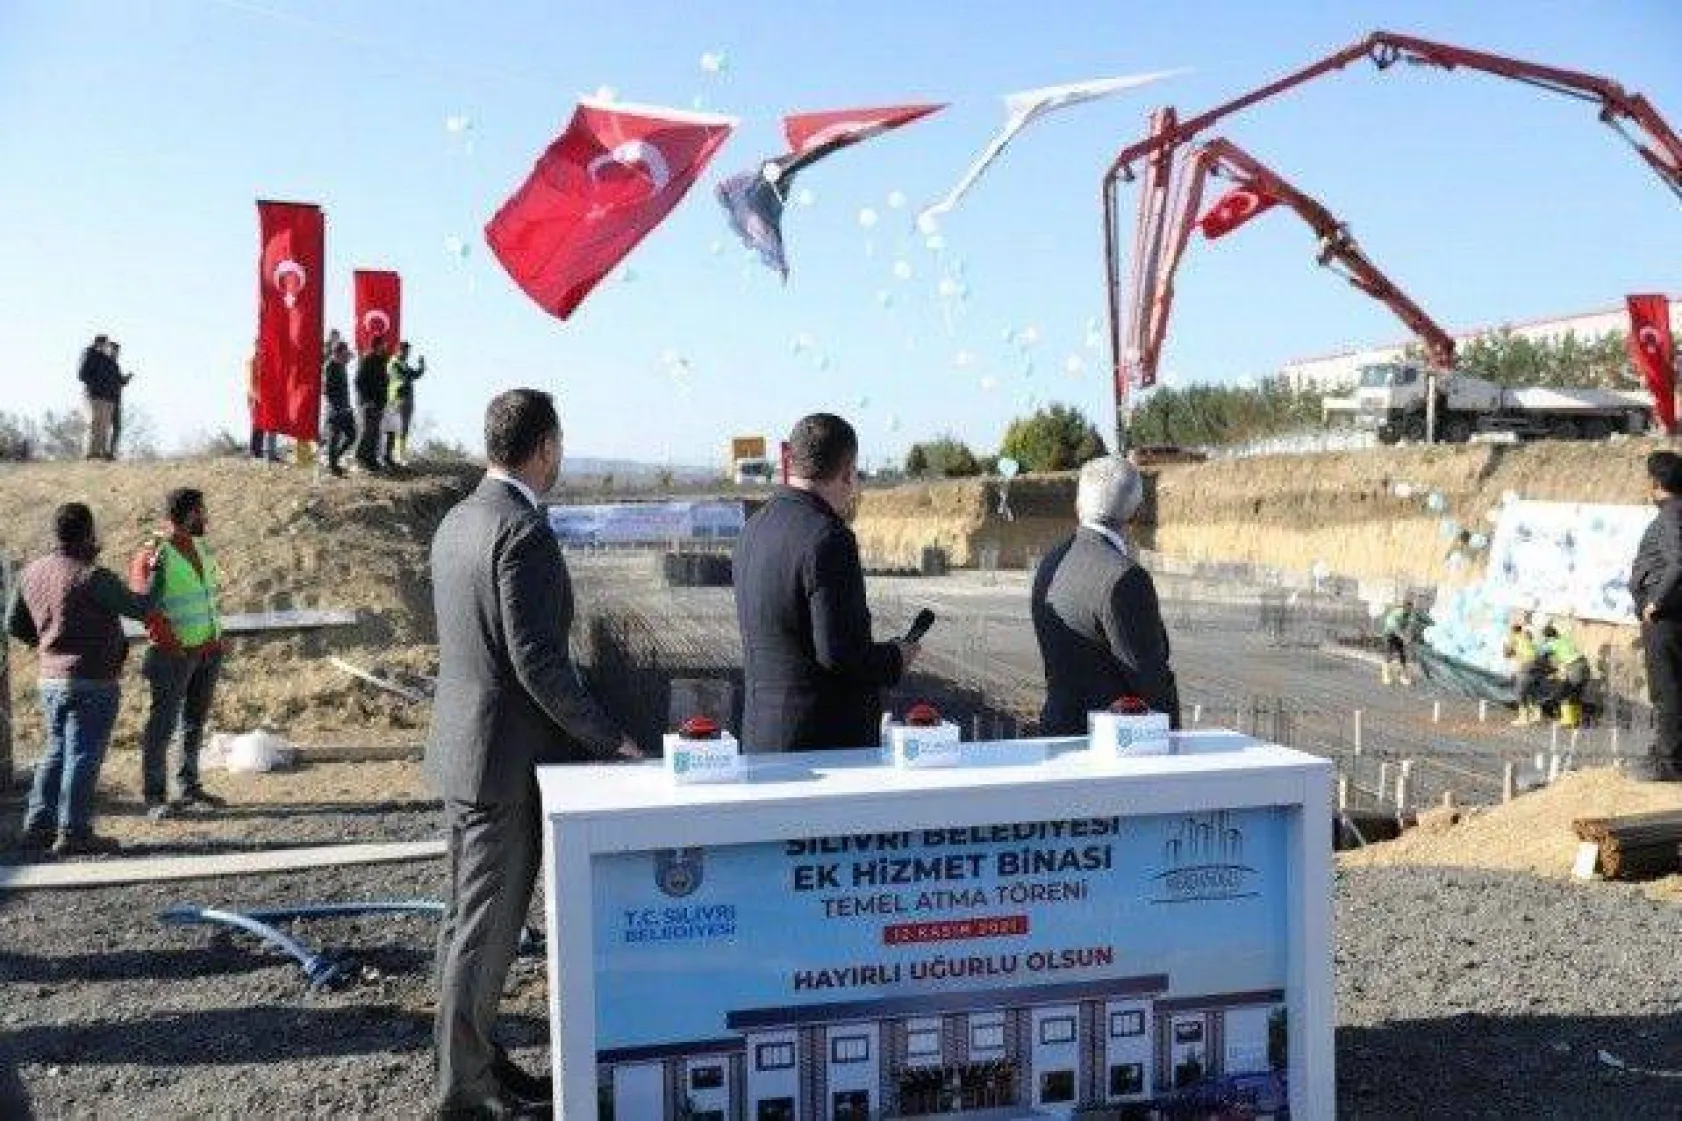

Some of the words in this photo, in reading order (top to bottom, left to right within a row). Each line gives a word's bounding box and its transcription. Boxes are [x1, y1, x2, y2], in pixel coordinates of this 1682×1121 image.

[794, 863, 840, 892] EK
[821, 890, 909, 918] TEMEL
[915, 887, 988, 912] ATMA
[794, 961, 901, 990] HAYIRLI
[910, 953, 1017, 980] UĞURLU
[1026, 946, 1114, 972] OLSUN
